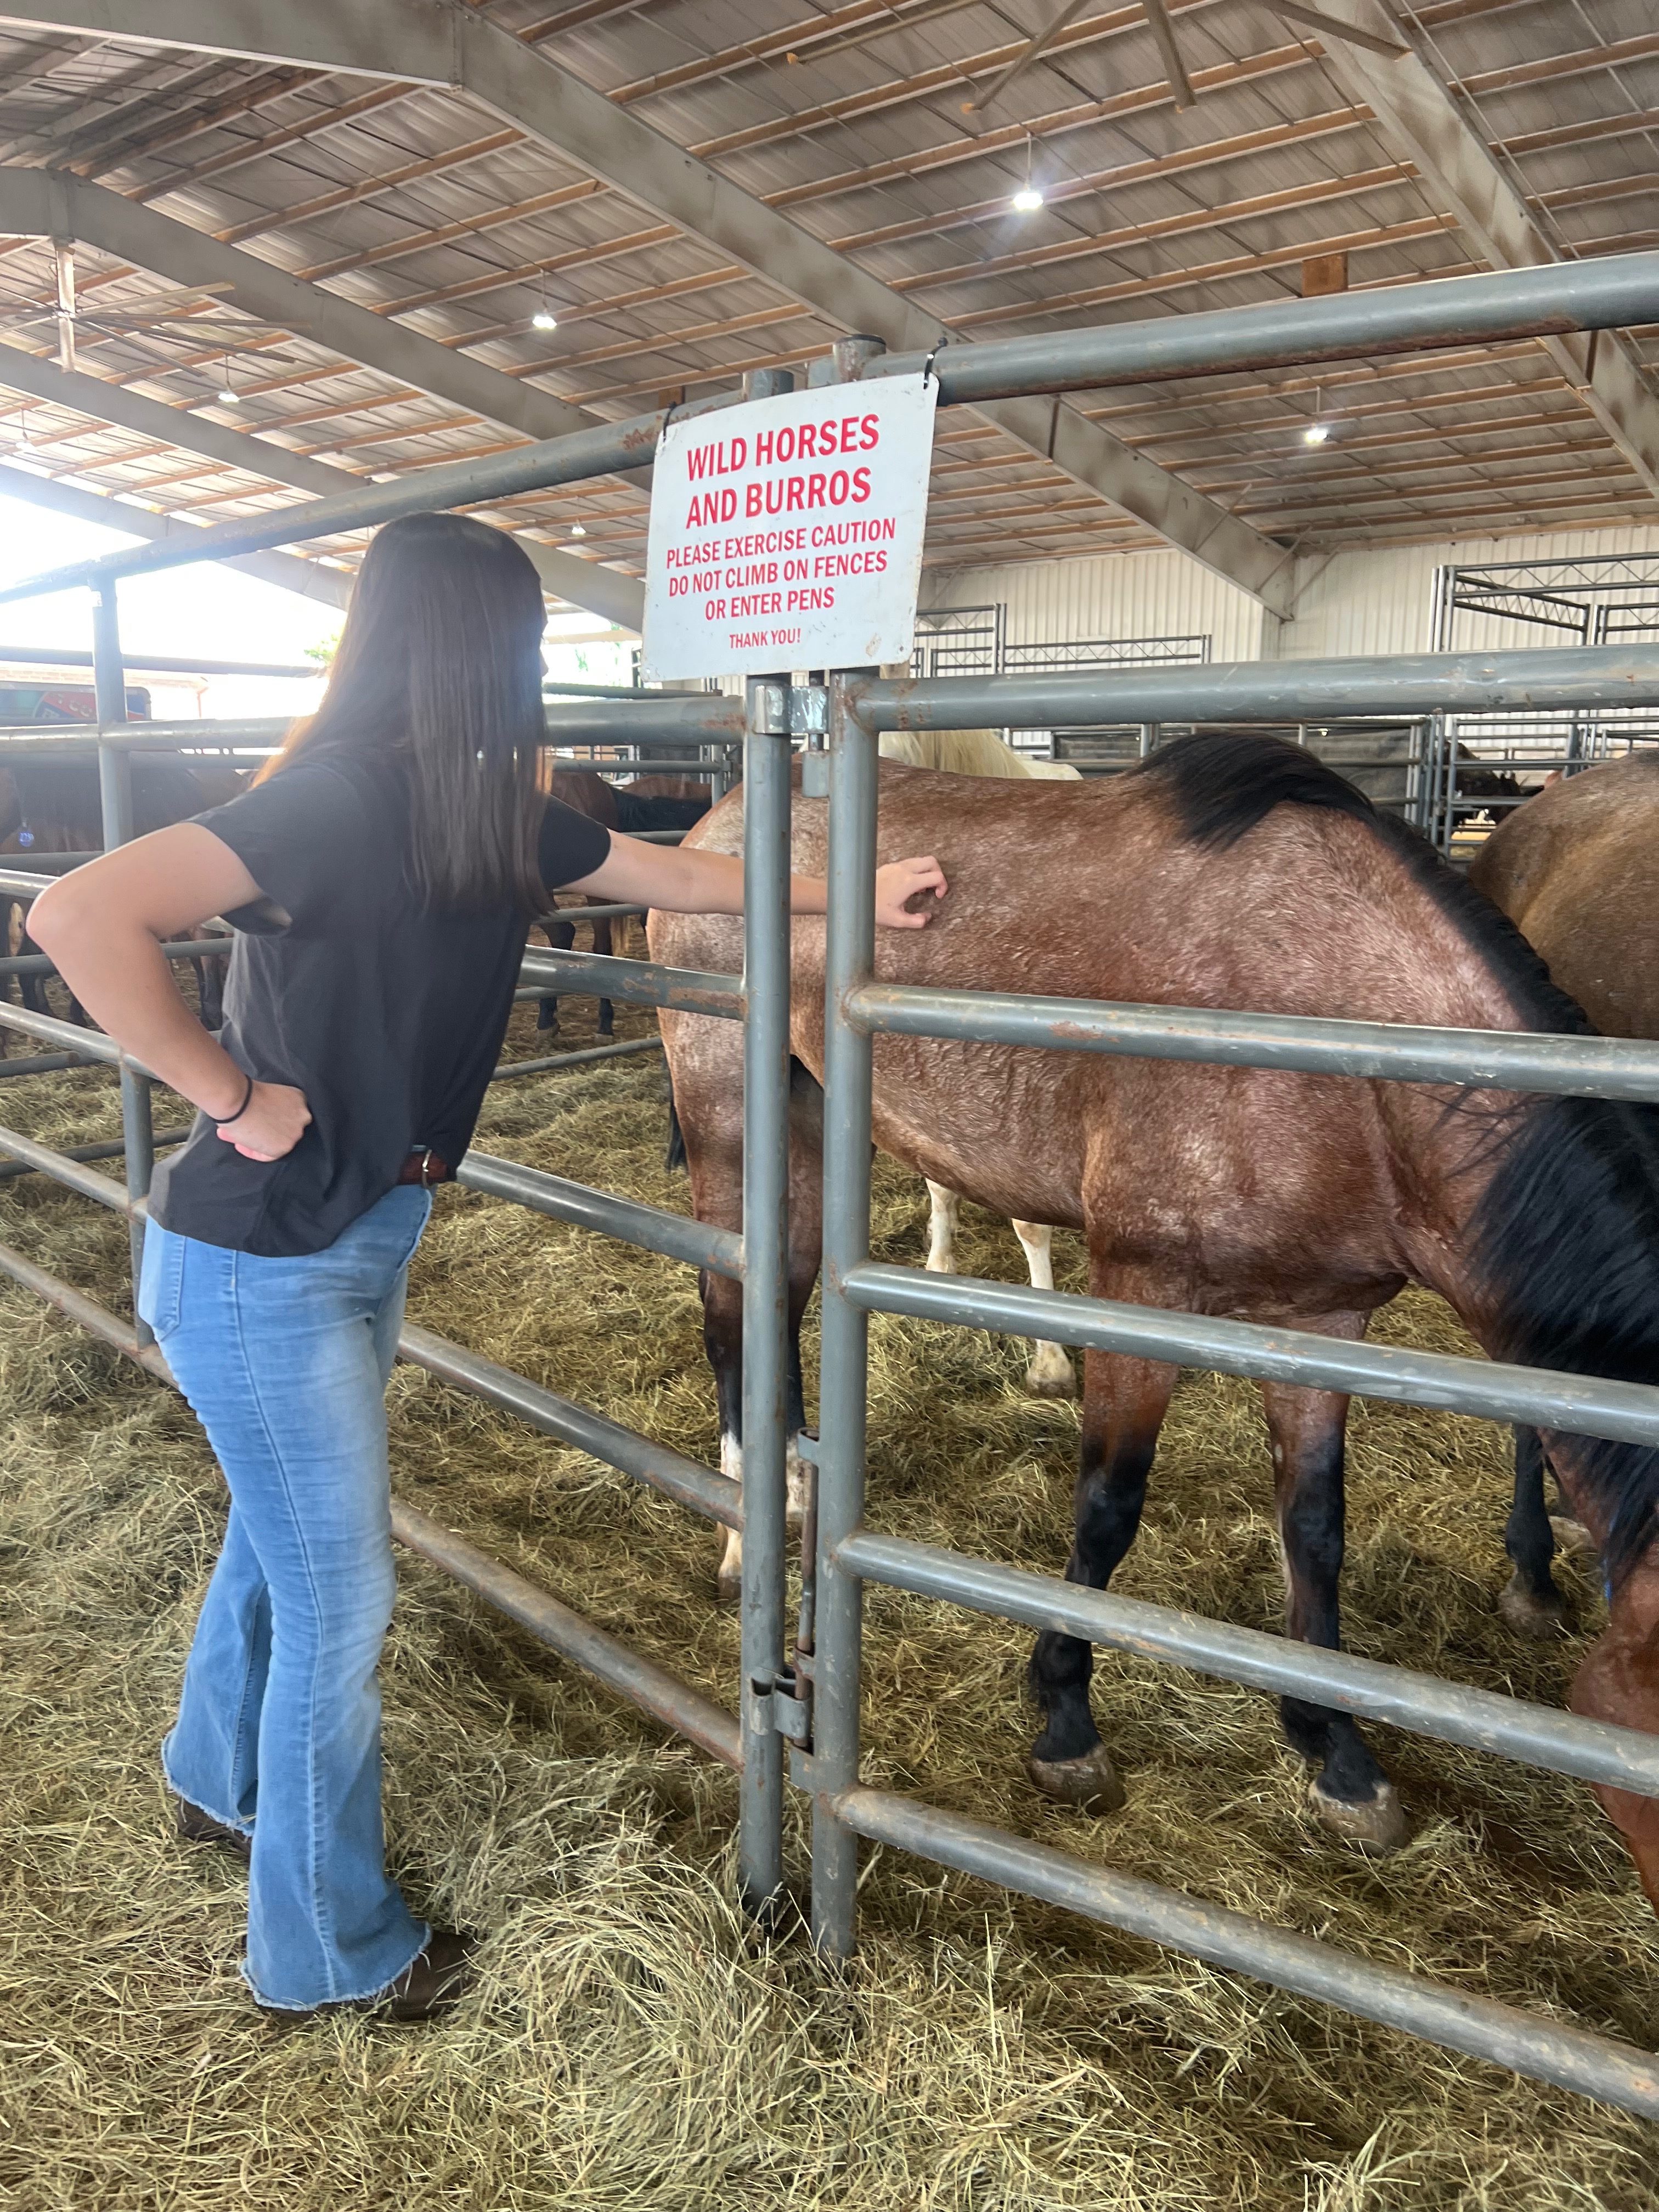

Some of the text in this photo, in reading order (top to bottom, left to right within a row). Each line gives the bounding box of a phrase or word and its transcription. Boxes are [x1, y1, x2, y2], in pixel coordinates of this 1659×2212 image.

[687, 413, 879, 482] WILD HORSES
[685, 466, 872, 529] AND BURROS
[666, 517, 896, 569] PLEASE EXERCISE CAUTION
[669, 550, 888, 597] DO NOT CLIMB ON FENCES
[705, 586, 835, 620] OR ENTER PENS
[729, 628, 801, 648] THANK YOU!
